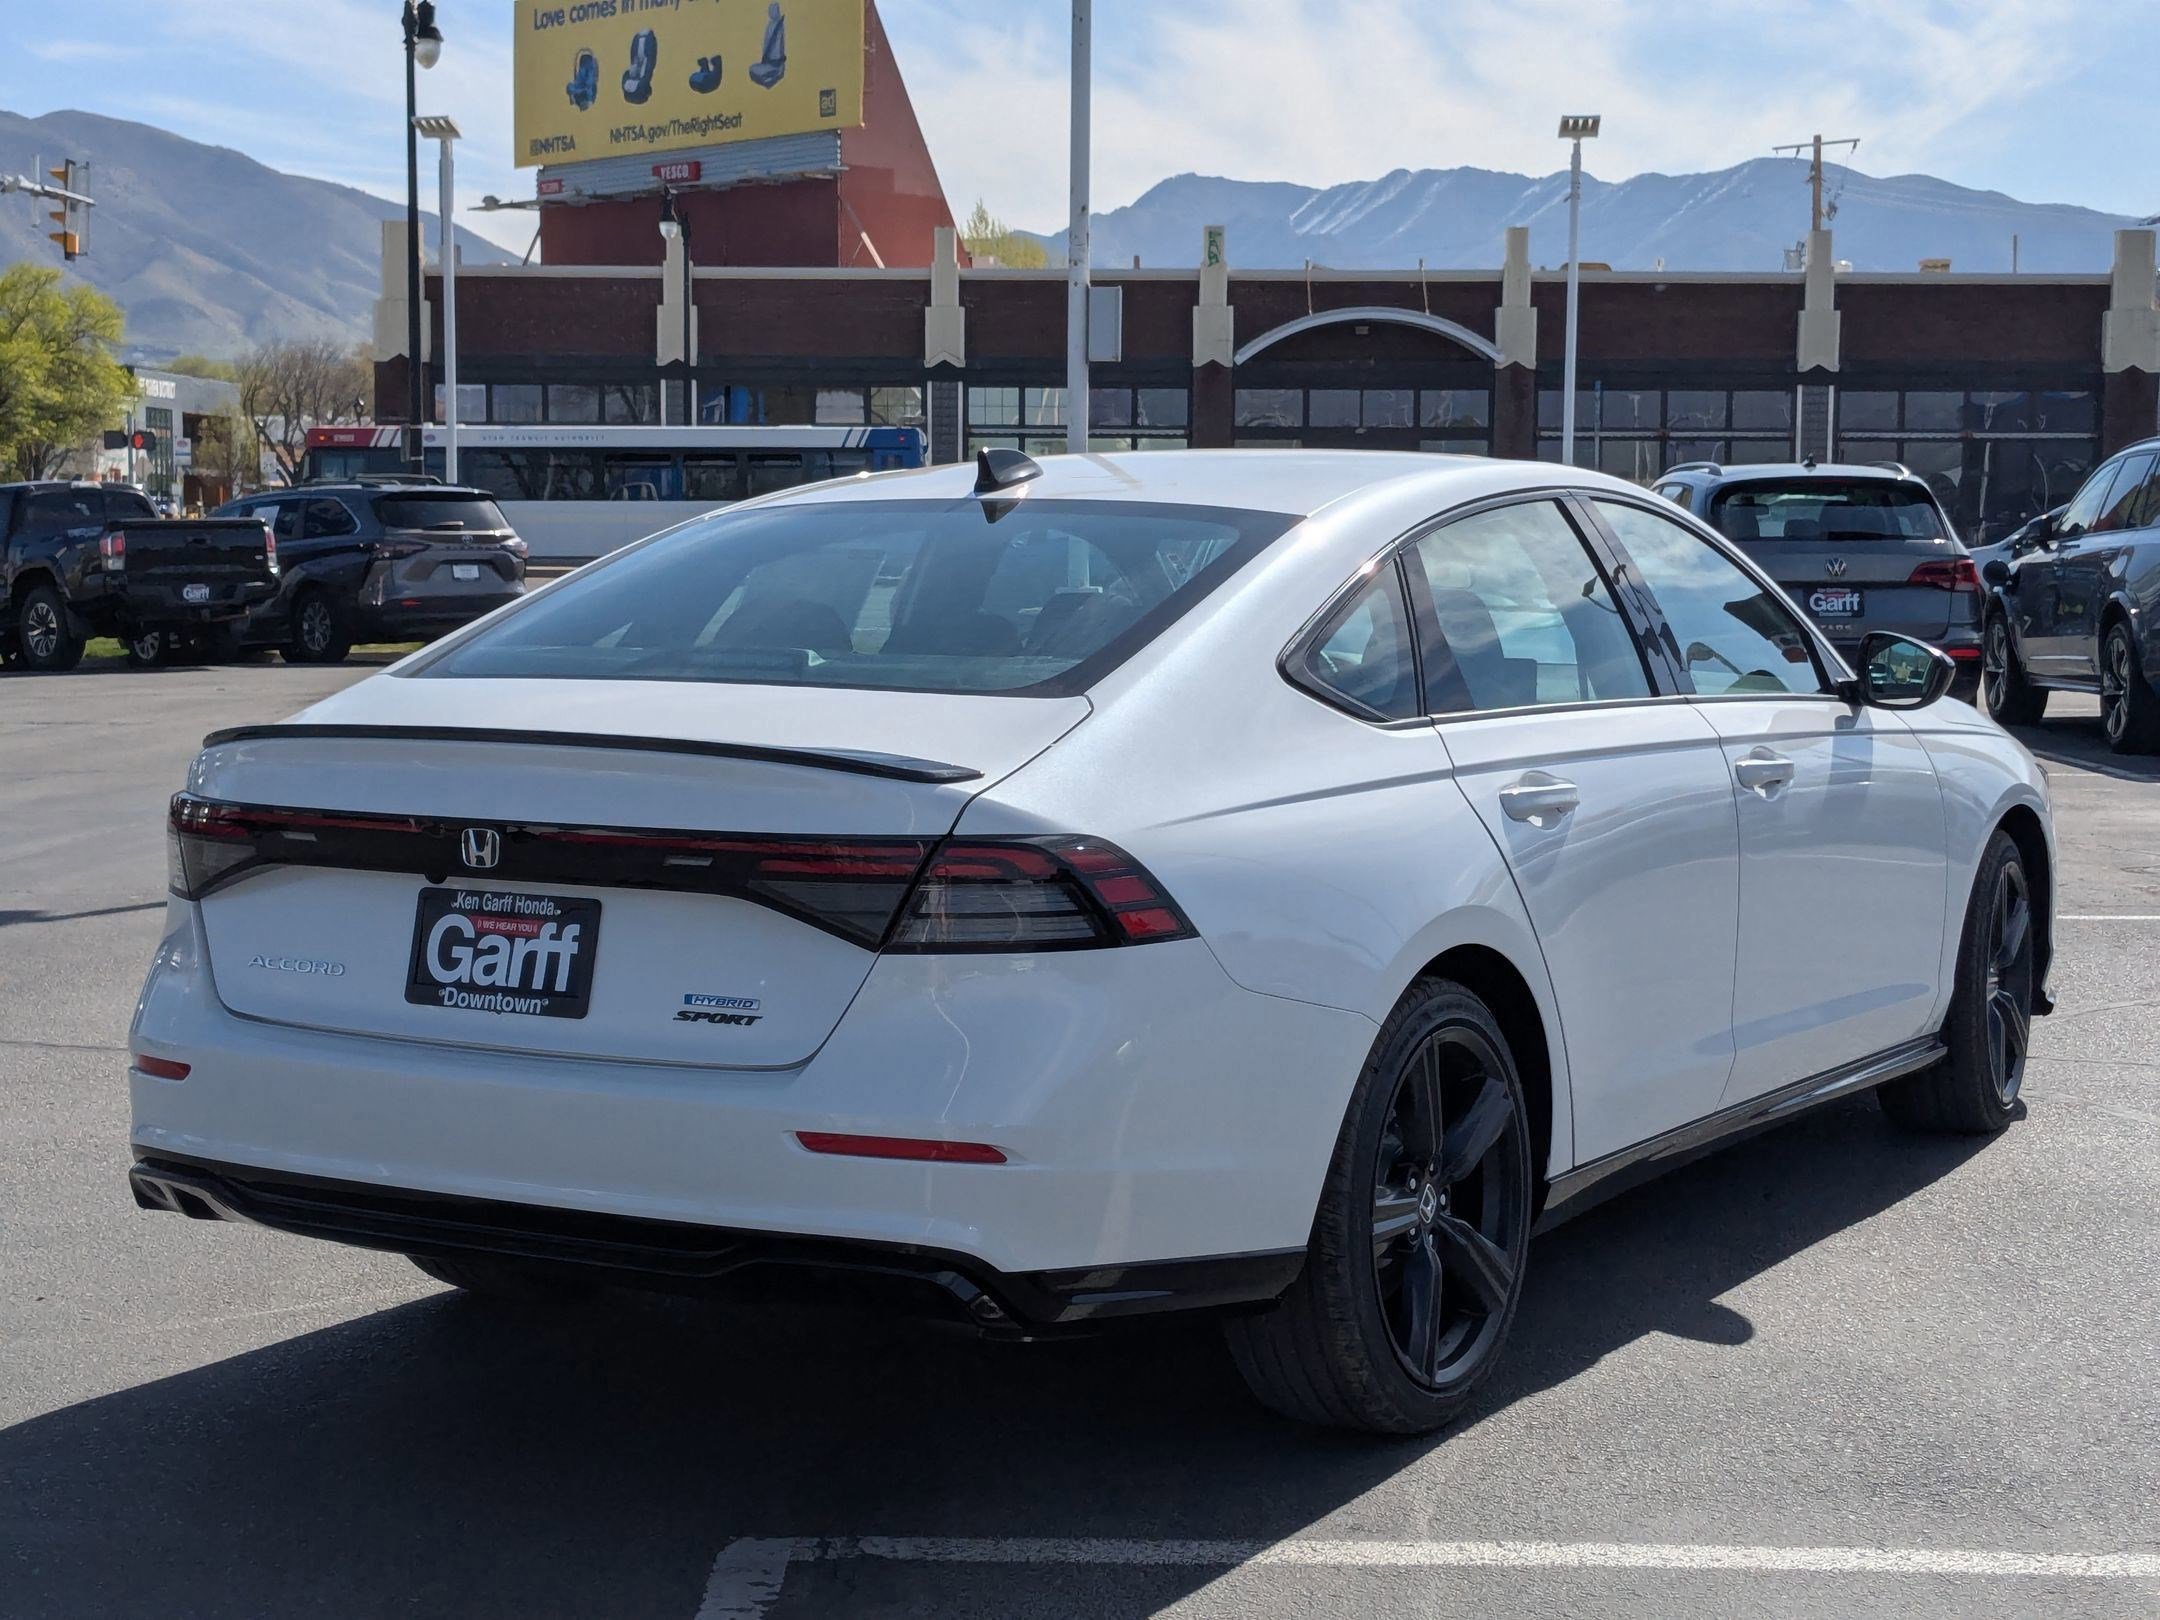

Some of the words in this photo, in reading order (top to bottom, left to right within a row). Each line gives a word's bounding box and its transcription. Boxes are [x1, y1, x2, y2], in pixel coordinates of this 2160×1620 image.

[534, 8, 565, 30] Love
[569, 2, 617, 23] comes
[621, 0, 635, 14] in
[610, 112, 743, 144] NHTSA.gov/TheRightSeat
[539, 135, 576, 154] NHTSA
[660, 164, 690, 180] YESCO
[1809, 592, 1860, 612] Garff
[456, 891, 479, 911] Ken
[482, 893, 513, 912] Garff
[515, 898, 555, 916] Honda
[482, 920, 495, 929] WE
[495, 921, 517, 931] HEAR
[517, 923, 533, 933] YOU
[426, 913, 581, 992] Garff
[247, 954, 345, 976] ACCORD
[443, 987, 543, 1014] Downtown
[693, 995, 754, 1008] HYBRID
[672, 1010, 763, 1026] SPORT
